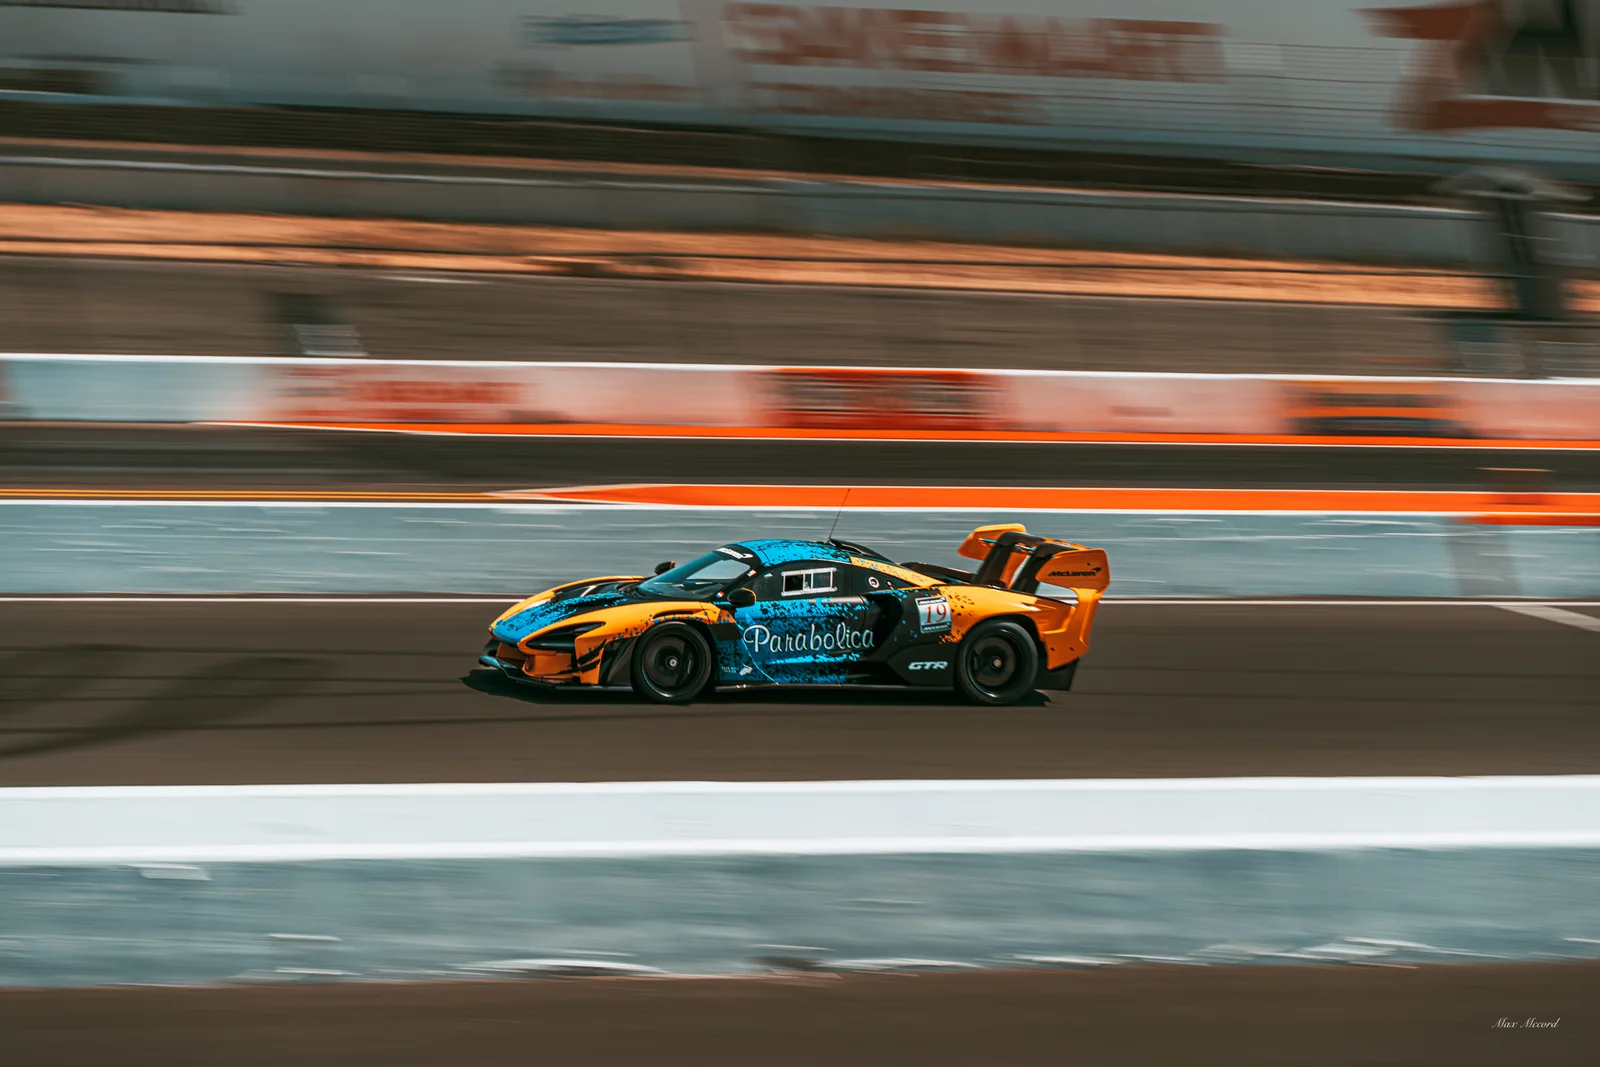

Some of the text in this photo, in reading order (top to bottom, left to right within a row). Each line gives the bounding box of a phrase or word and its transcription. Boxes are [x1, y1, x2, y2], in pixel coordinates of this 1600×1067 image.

[924, 603, 947, 625] 19
[743, 621, 875, 653] Parabolica
[908, 661, 949, 670] GTR
